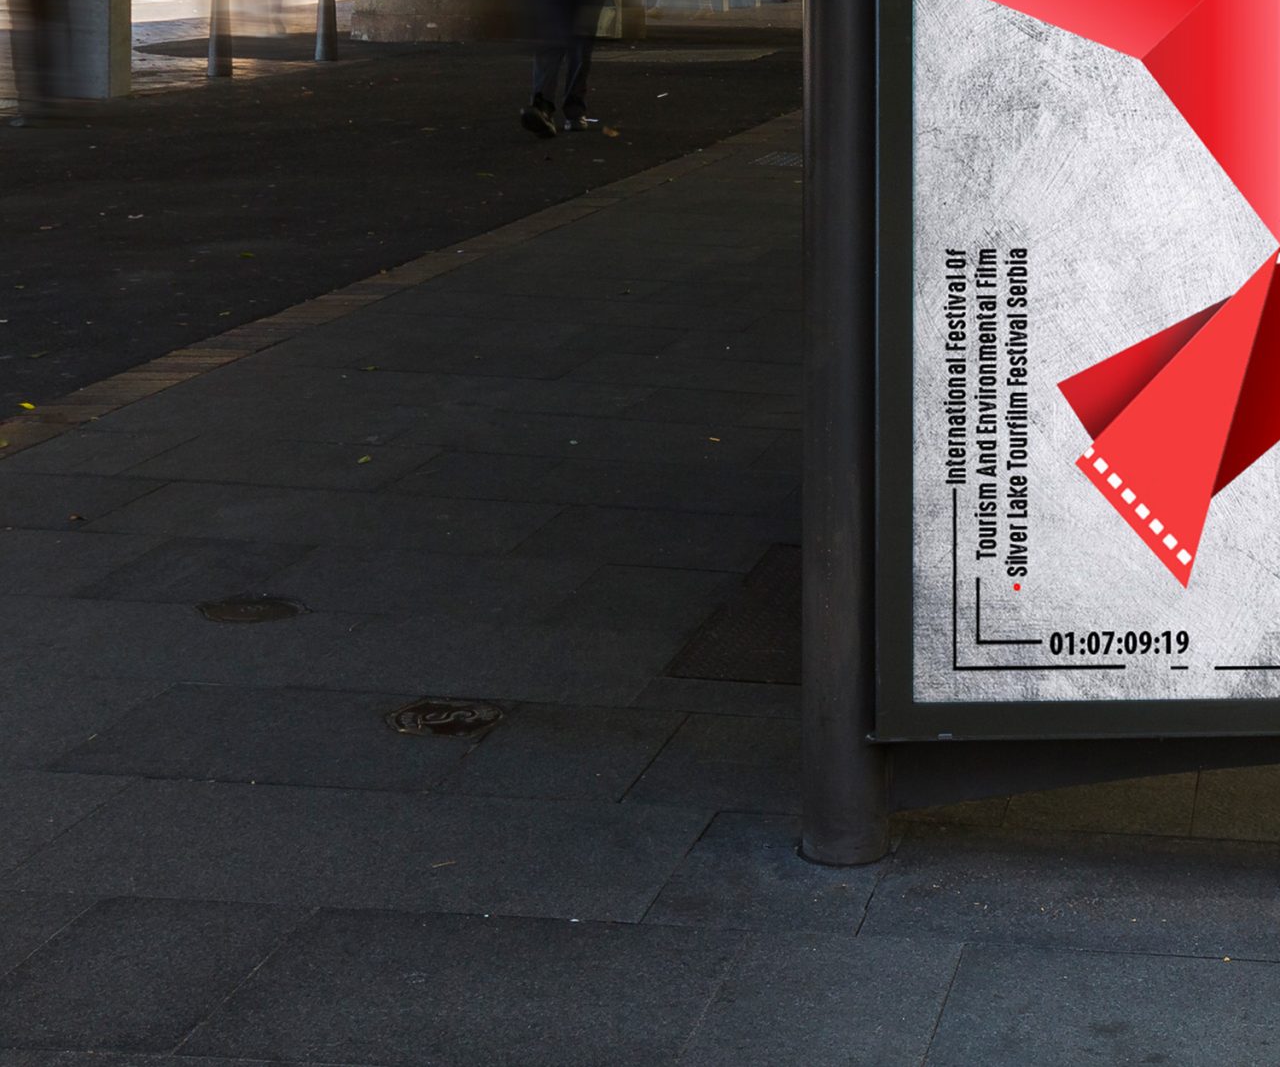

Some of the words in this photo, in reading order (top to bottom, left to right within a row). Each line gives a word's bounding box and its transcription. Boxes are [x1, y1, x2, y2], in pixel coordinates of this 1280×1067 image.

[945, 248, 967, 269] Of
[974, 248, 997, 288] Film
[1004, 248, 1028, 308] Serbia
[943, 275, 967, 351] Festival
[974, 295, 997, 434] Environmental
[1004, 313, 1028, 386] Festival
[943, 358, 967, 485] International
[1004, 392, 1028, 471] Tourfilm
[975, 440, 997, 477] And
[974, 483, 997, 561] Tourism
[1006, 475, 1028, 518] Lake
[1004, 523, 1028, 577] Silver
[1049, 630, 1190, 656] 01:07:09:19
